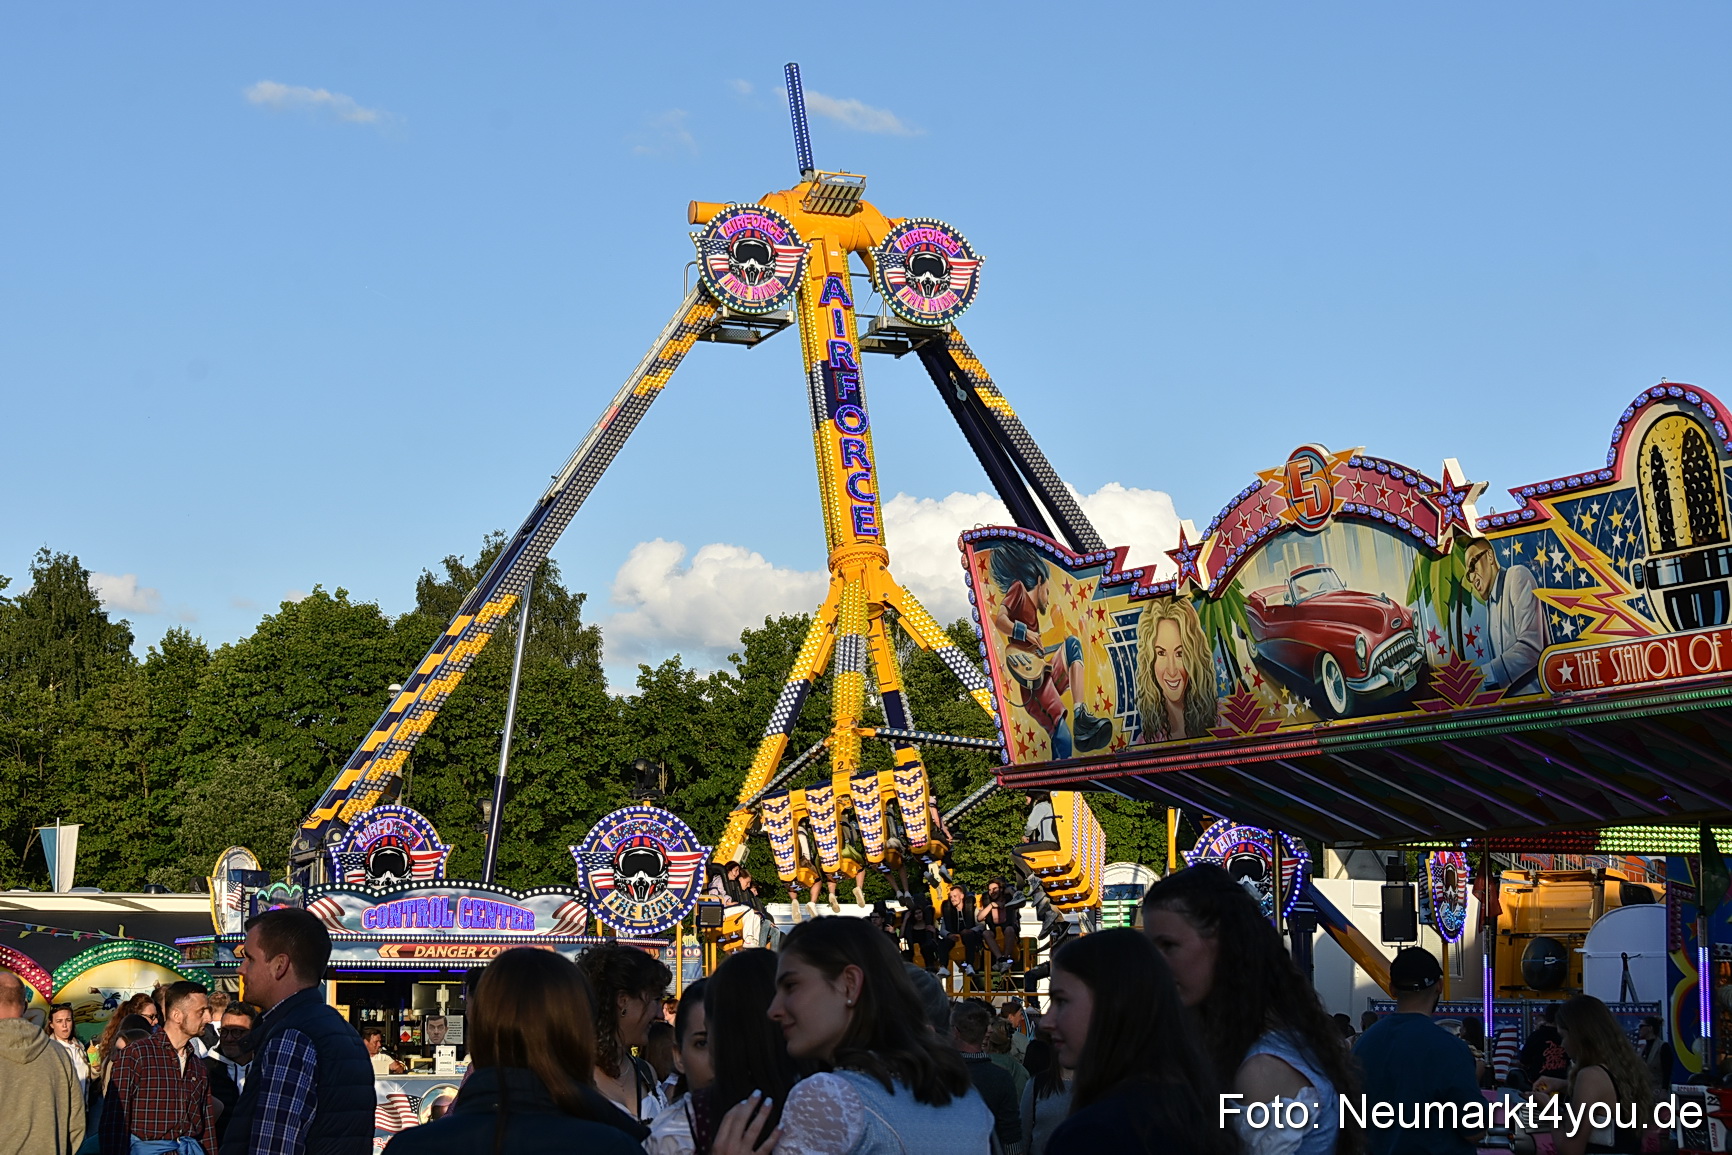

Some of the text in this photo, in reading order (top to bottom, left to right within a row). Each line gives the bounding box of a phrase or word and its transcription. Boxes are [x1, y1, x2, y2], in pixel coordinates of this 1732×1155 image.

[724, 212, 787, 241] AIRFORCE
[899, 228, 960, 257] AIRFORCE
[721, 273, 784, 301] THE RIDE
[899, 285, 959, 313] THE RIDE
[820, 275, 879, 537] AIRFORCE
[1574, 632, 1723, 689] THE STATION OF
[837, 760, 845, 770] 2
[361, 895, 536, 931] CONTROL CENTER
[607, 891, 679, 920] THE RIDE
[414, 944, 477, 959] DANGER
